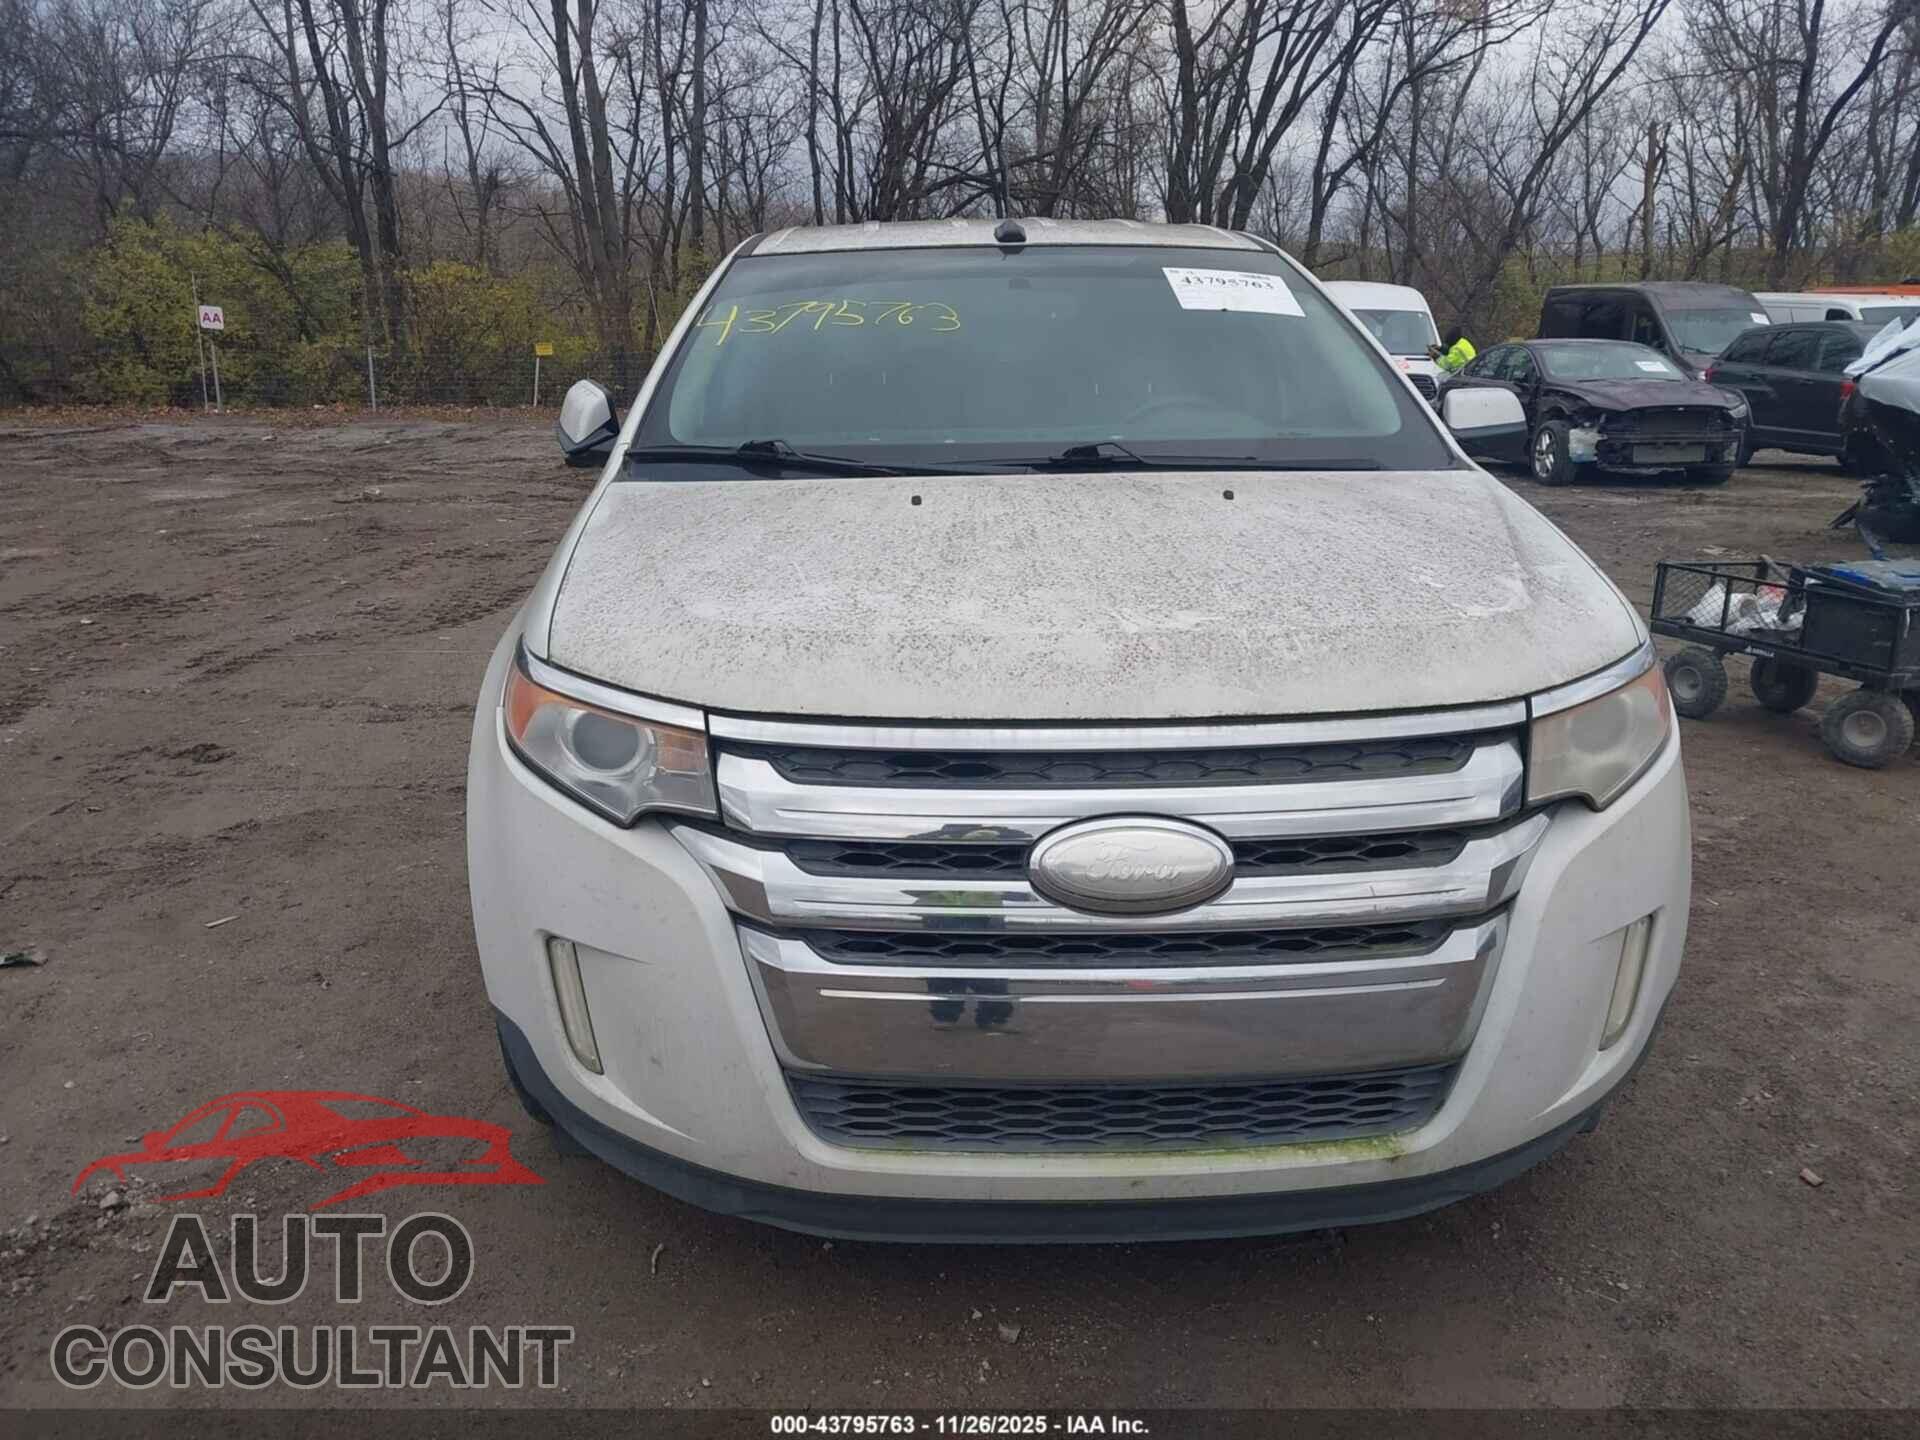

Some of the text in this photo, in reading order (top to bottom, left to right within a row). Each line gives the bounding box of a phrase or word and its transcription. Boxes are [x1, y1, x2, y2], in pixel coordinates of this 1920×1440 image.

[1181, 276, 1274, 290] 43795763
[203, 312, 221, 323] AA
[696, 300, 961, 345] 43795763
[1086, 841, 1186, 881] Ford
